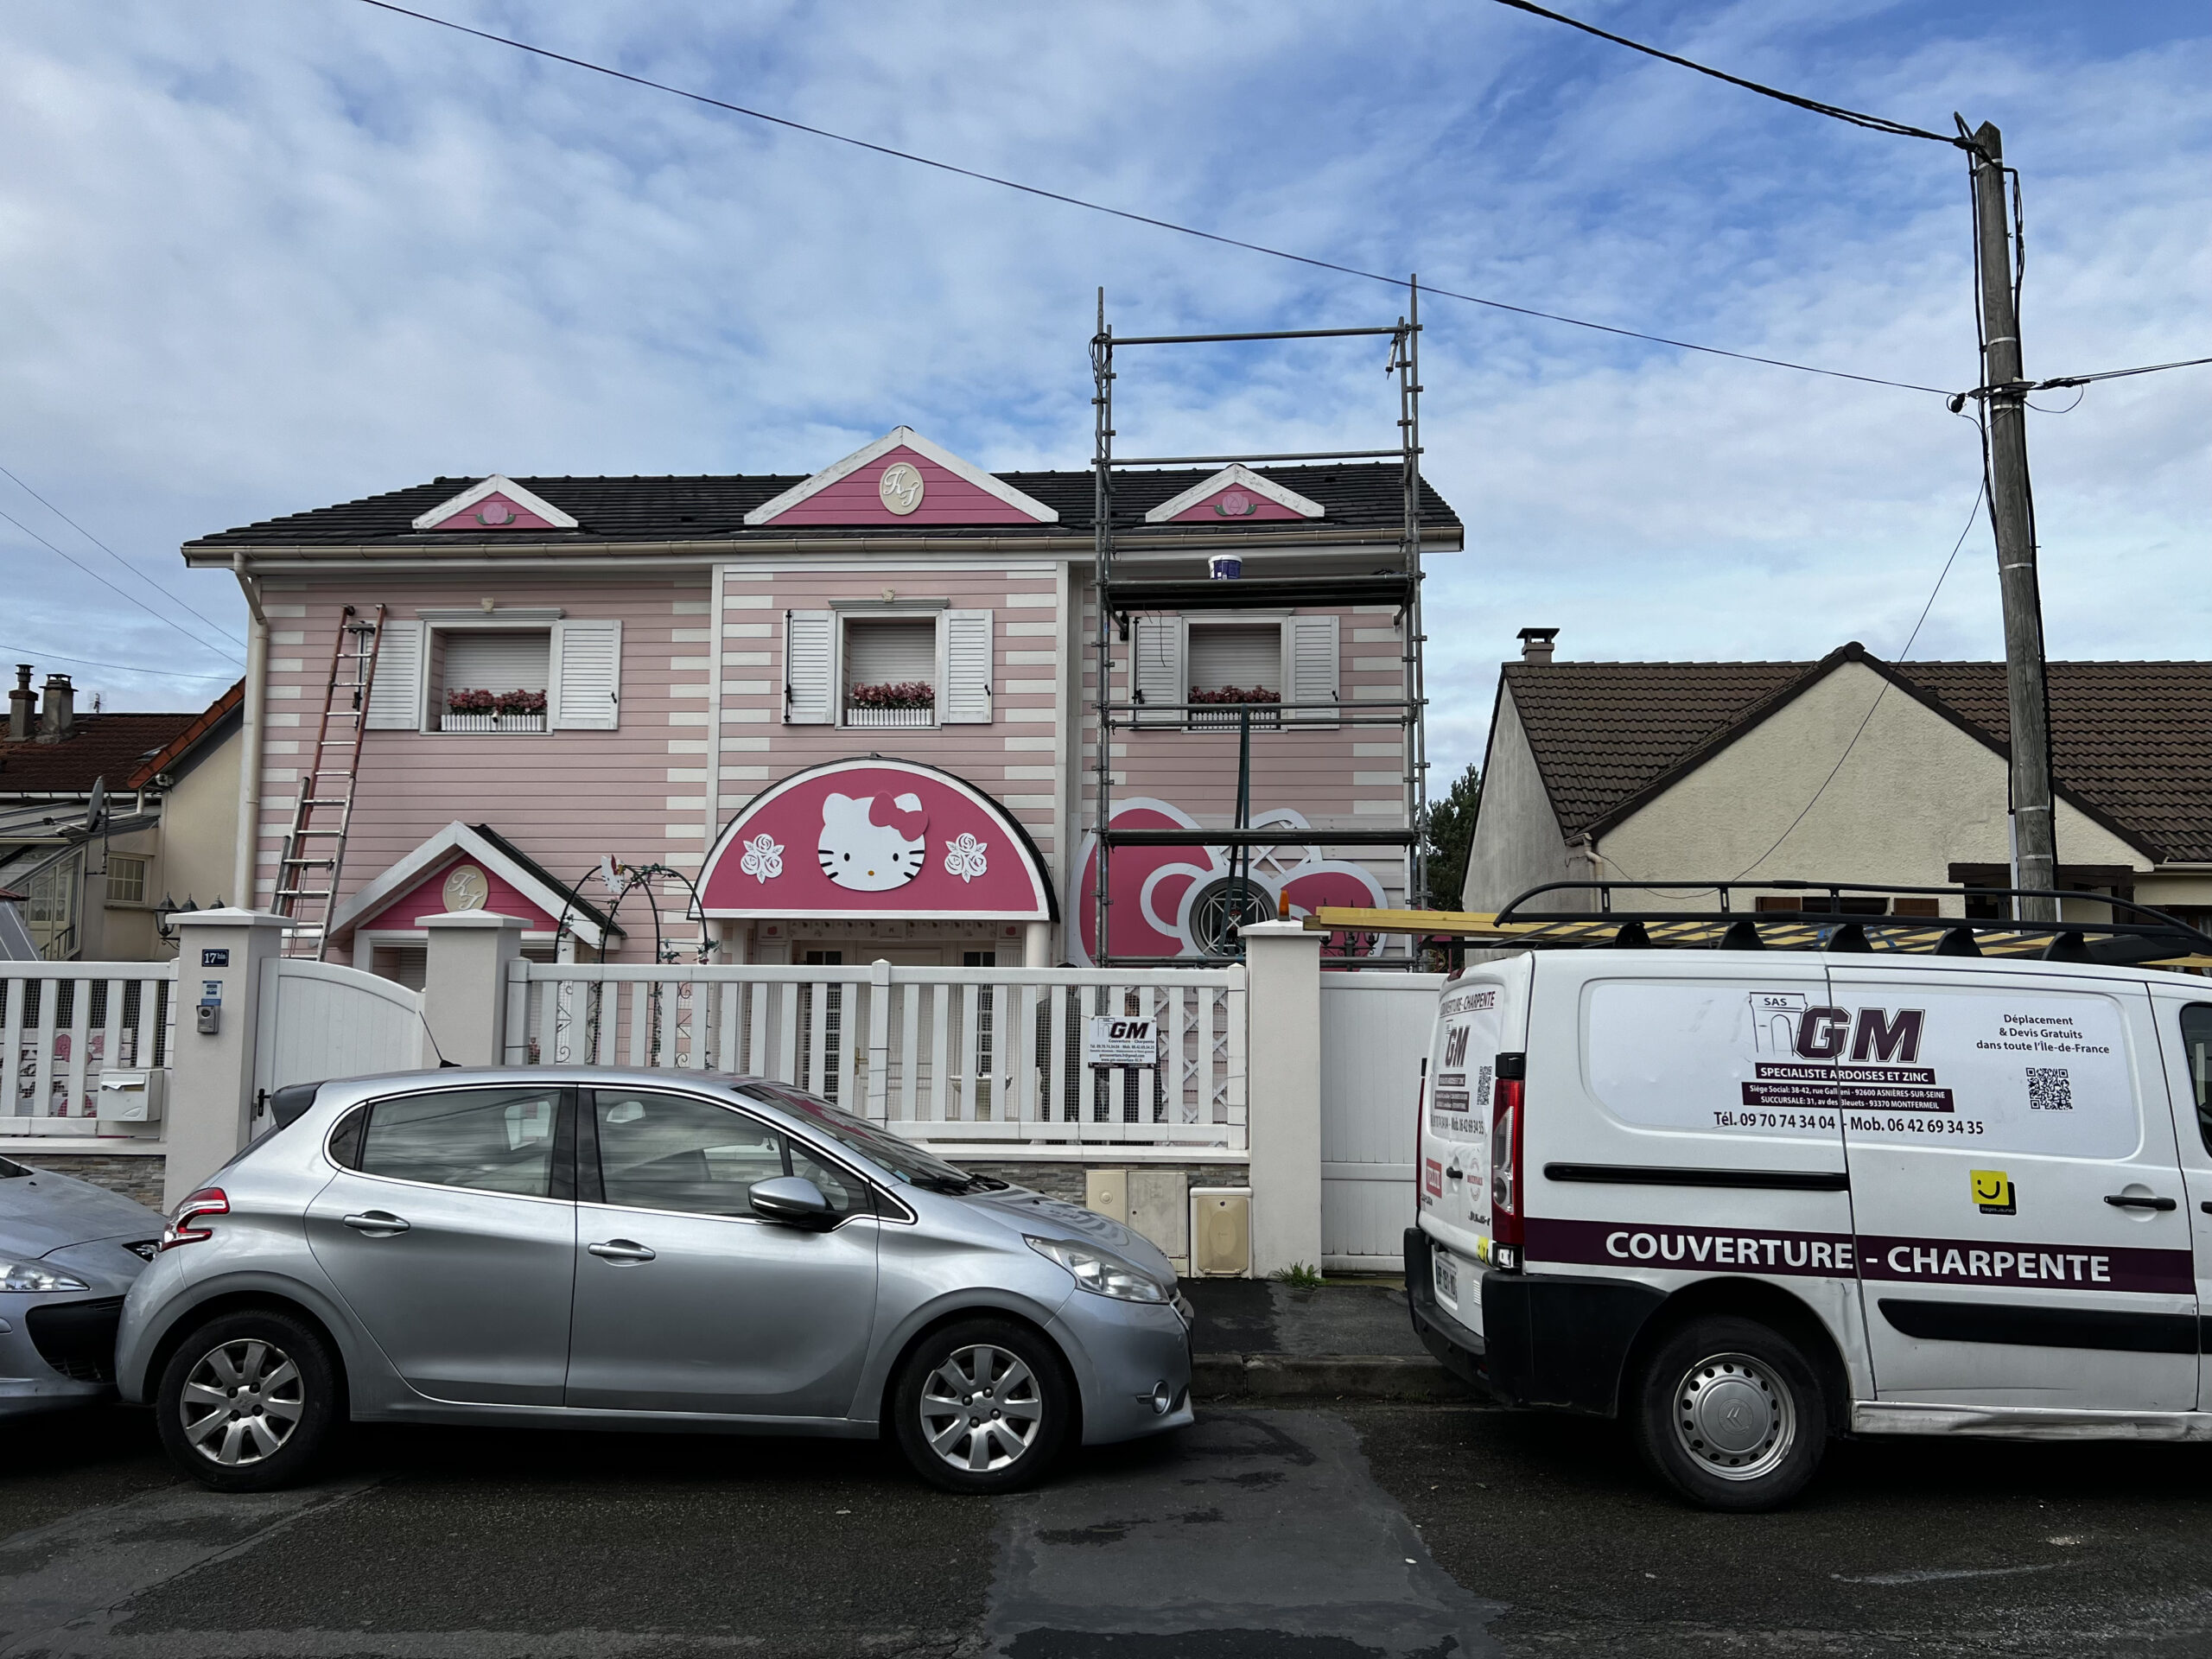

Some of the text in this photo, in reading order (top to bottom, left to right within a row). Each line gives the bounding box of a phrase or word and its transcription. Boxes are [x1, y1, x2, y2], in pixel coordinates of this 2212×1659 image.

[204, 952, 217, 963] 17
[1764, 997, 1788, 1007] SAS
[2004, 1014, 2074, 1026] Déplacement
[1110, 1022, 1149, 1039] GM
[1794, 1005, 1926, 1064] GM
[1999, 1027, 2083, 1039] & Devis Gratuits
[1976, 1040, 2002, 1050] dans
[2004, 1042, 2032, 1051] toute
[1760, 1067, 1929, 1083] SPECIALISTE ARDOISES ET ZINC
[1769, 1085, 1790, 1094] Social:
[1791, 1086, 1812, 1095] 38-42,
[1824, 1087, 1851, 1096] Galleni
[1877, 1089, 1946, 1098] ASNIÈRES-SUR-SEINE
[1761, 1096, 1806, 1104] SUCCURSALE:
[1713, 1111, 1737, 1126] Tél.
[1739, 1114, 1757, 1127] 09
[1759, 1114, 1777, 1128] 70
[1779, 1115, 1796, 1128] 74
[1799, 1115, 1816, 1128] 34
[1818, 1116, 1835, 1129] 04
[1851, 1116, 1885, 1131] Mob.
[1887, 1118, 1904, 1132] 06
[1907, 1119, 1924, 1133] 42
[1927, 1119, 1944, 1133] 69
[1948, 1120, 1964, 1134] 34
[1967, 1121, 1984, 1135] 35
[1605, 1231, 1853, 1270] COUVERTURE
[1887, 1246, 2111, 1282] CHARPENTE
